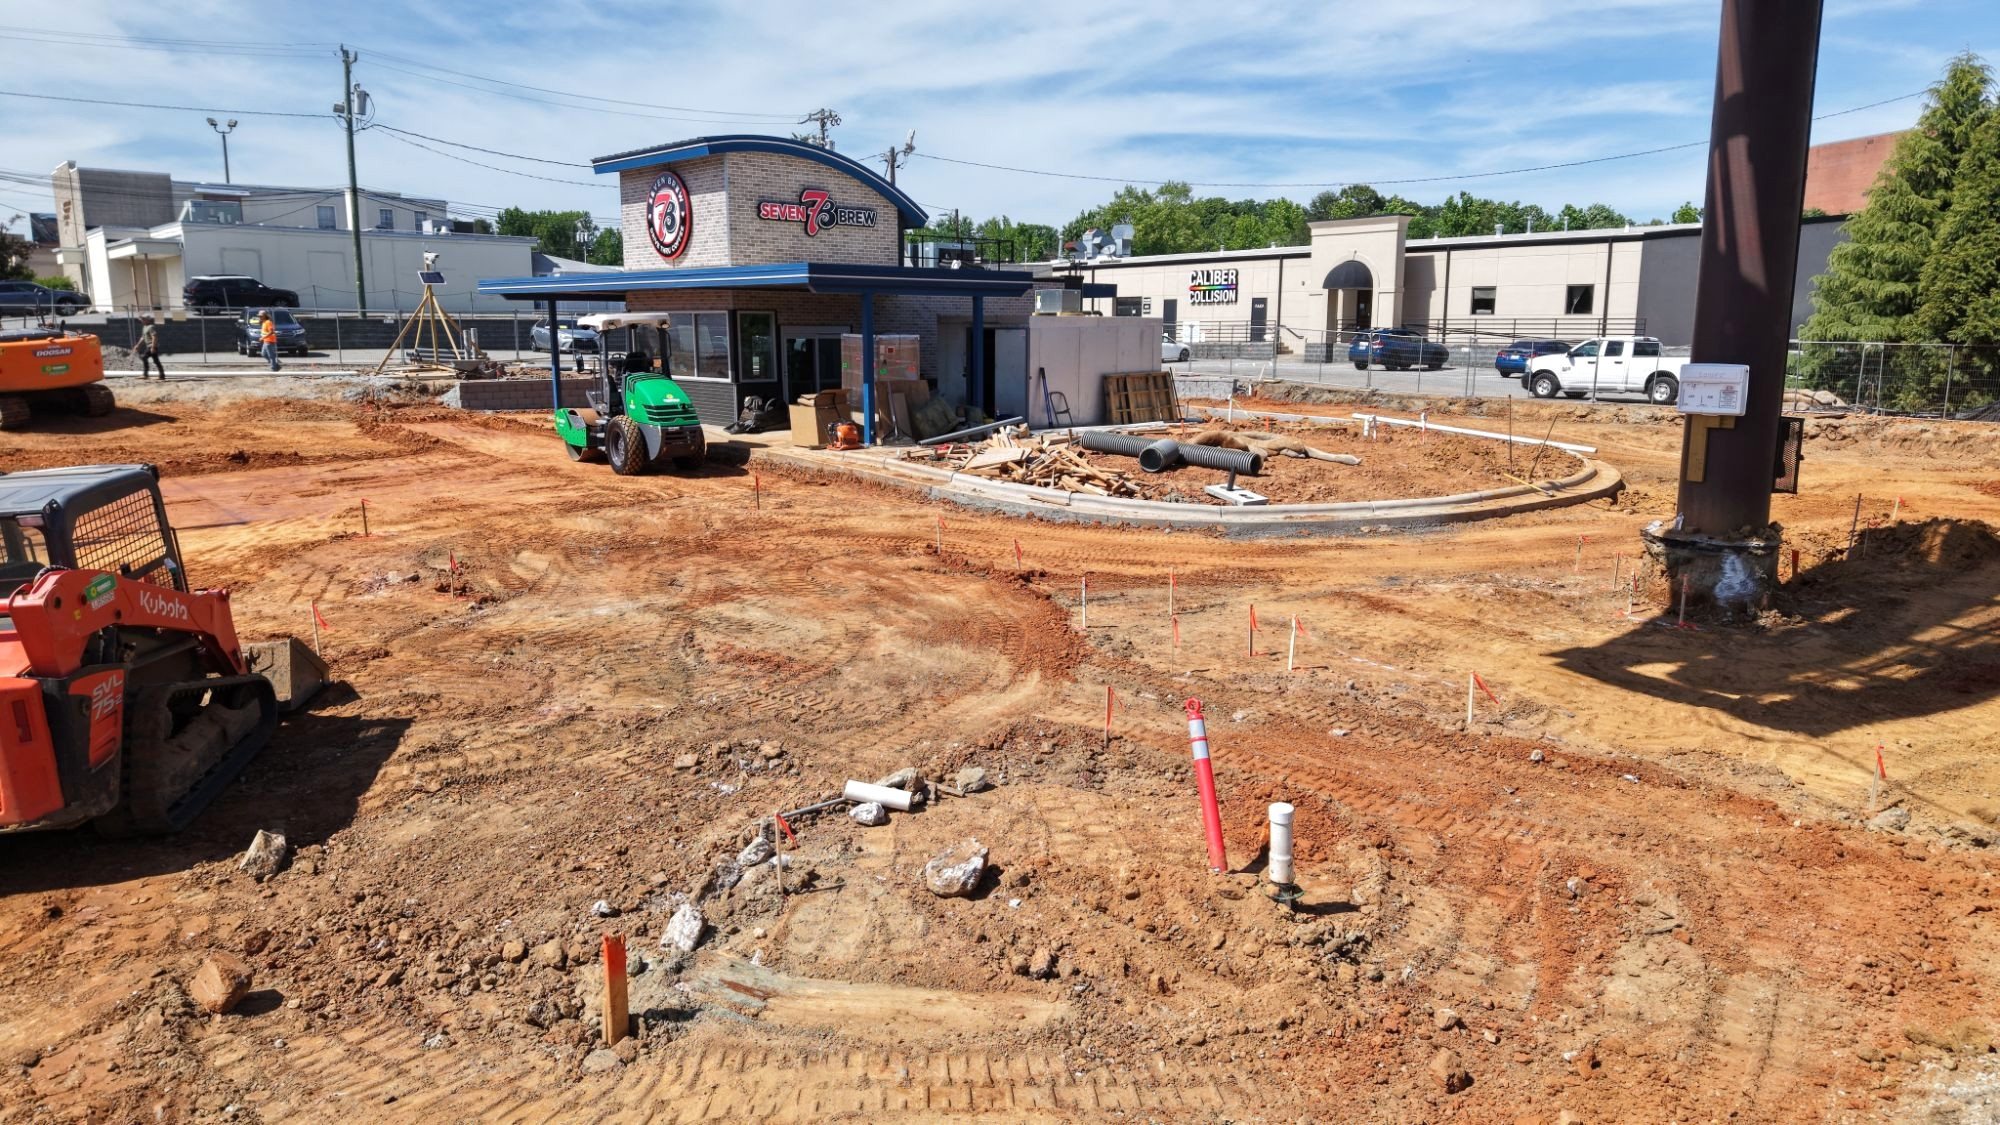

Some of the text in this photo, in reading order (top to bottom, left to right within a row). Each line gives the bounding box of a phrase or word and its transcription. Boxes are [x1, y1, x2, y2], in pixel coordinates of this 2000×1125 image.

[760, 202, 806, 222] SEVEN
[838, 208, 877, 226] BREW
[1189, 269, 1236, 286] CALIBER
[1189, 290, 1236, 303] COLLISION
[36, 348, 71, 357] DOOSAN
[139, 590, 189, 621] Kubota
[92, 674, 124, 702] SVL
